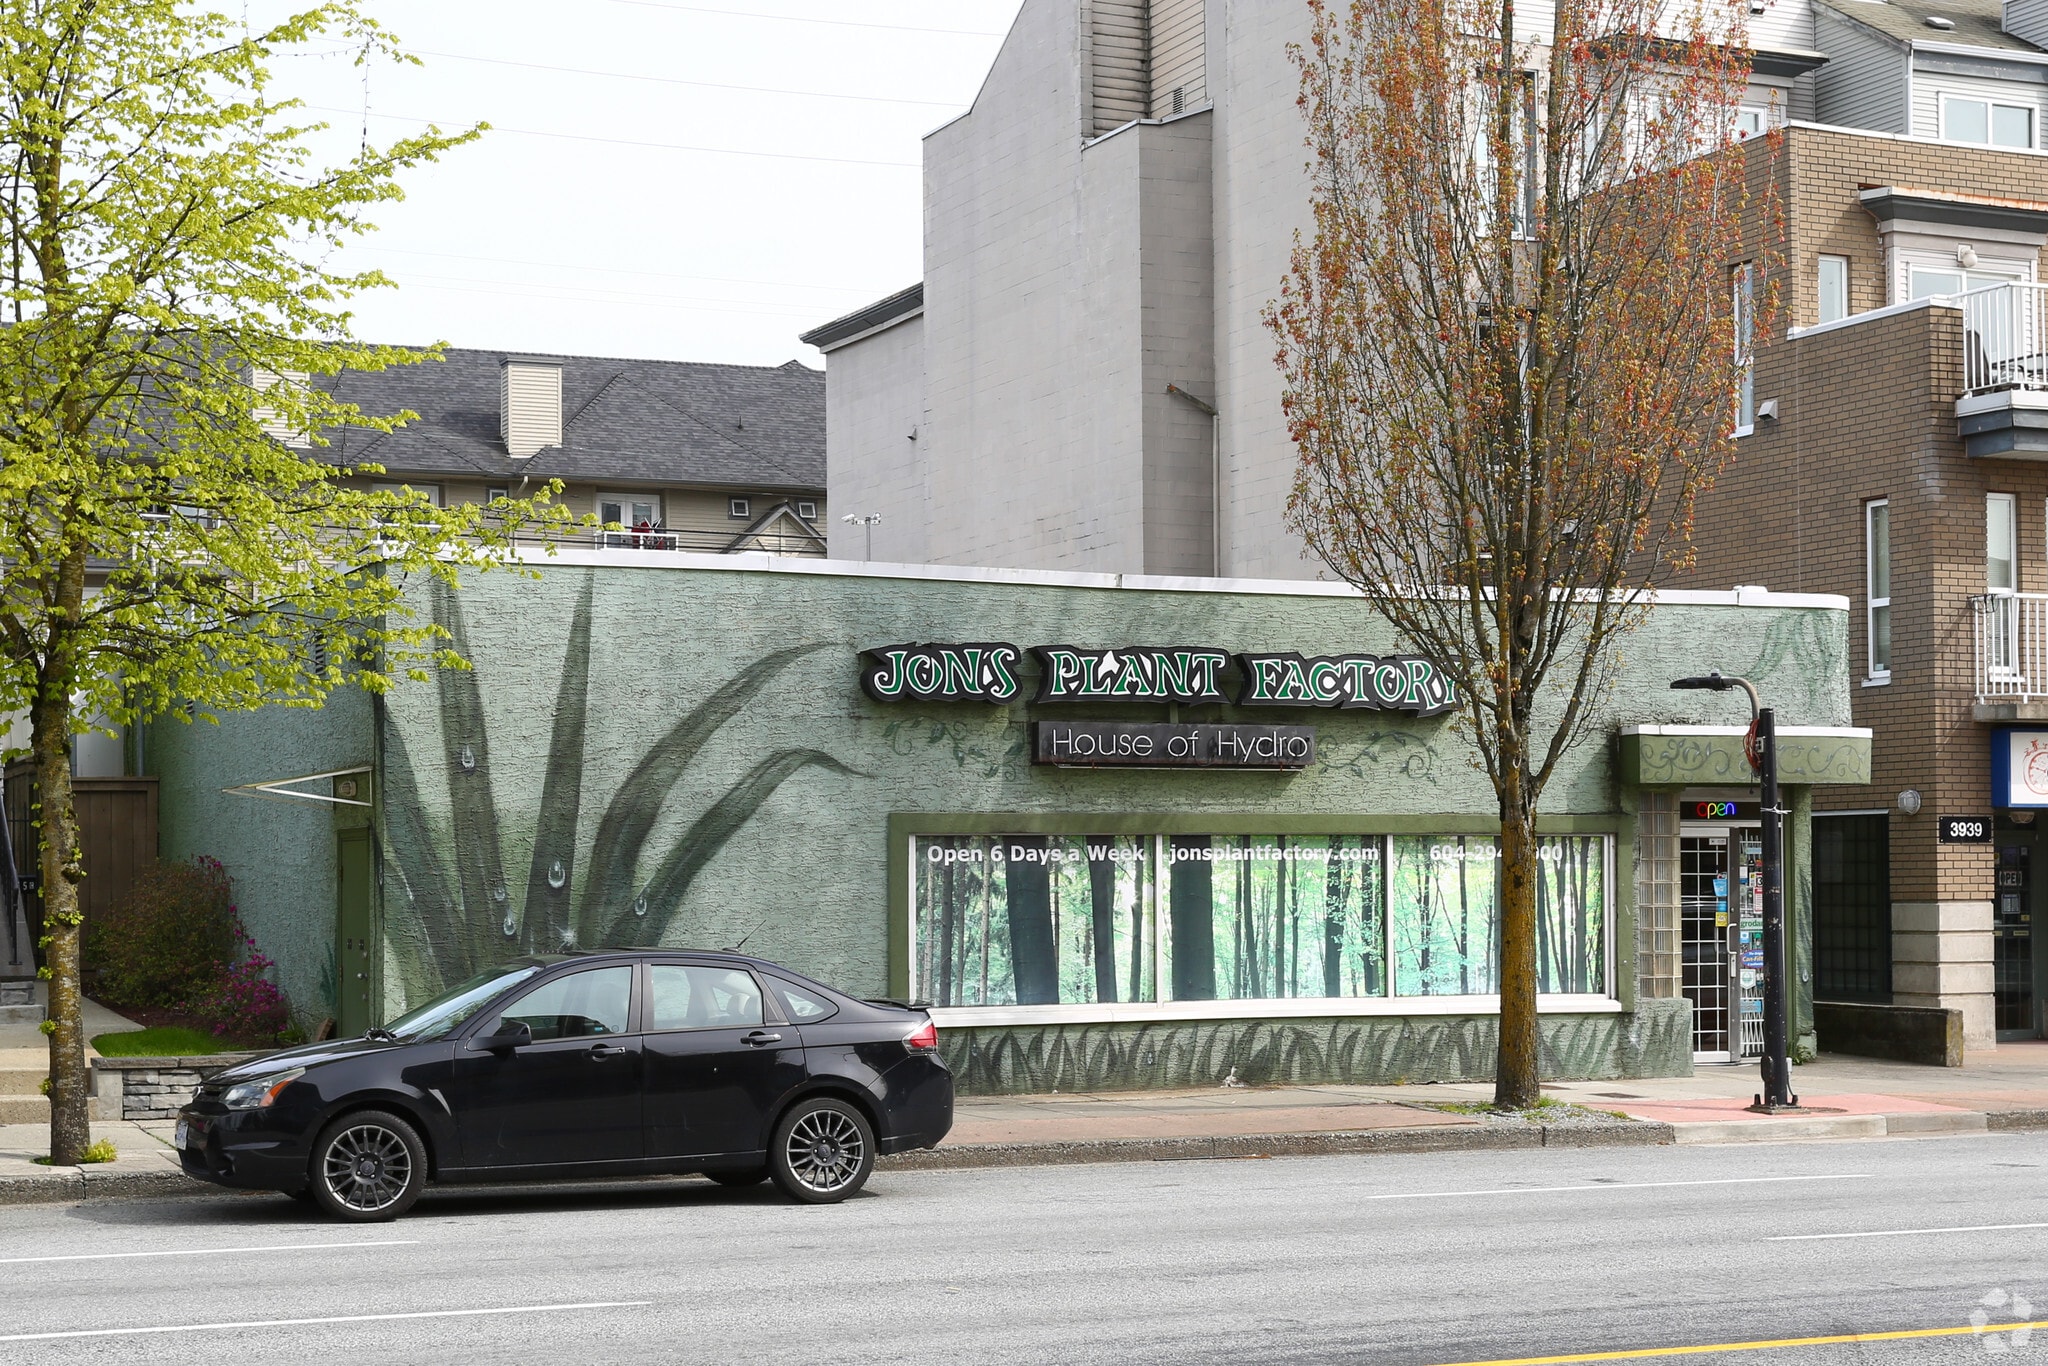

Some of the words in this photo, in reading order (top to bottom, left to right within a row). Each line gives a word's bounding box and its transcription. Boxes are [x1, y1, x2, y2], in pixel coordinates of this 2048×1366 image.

[1047, 650, 1226, 697] PLANT
[1053, 728, 1154, 757] House
[1167, 730, 1199, 757] of
[1218, 730, 1309, 763] Hydro
[1950, 822, 1983, 837] 3939
[927, 845, 983, 866] Open
[990, 845, 1003, 862] 6
[1010, 845, 1061, 866] Days
[1068, 849, 1080, 862] a
[1086, 845, 1145, 862] Week
[1169, 844, 1379, 865] jonsplantfactory.com
